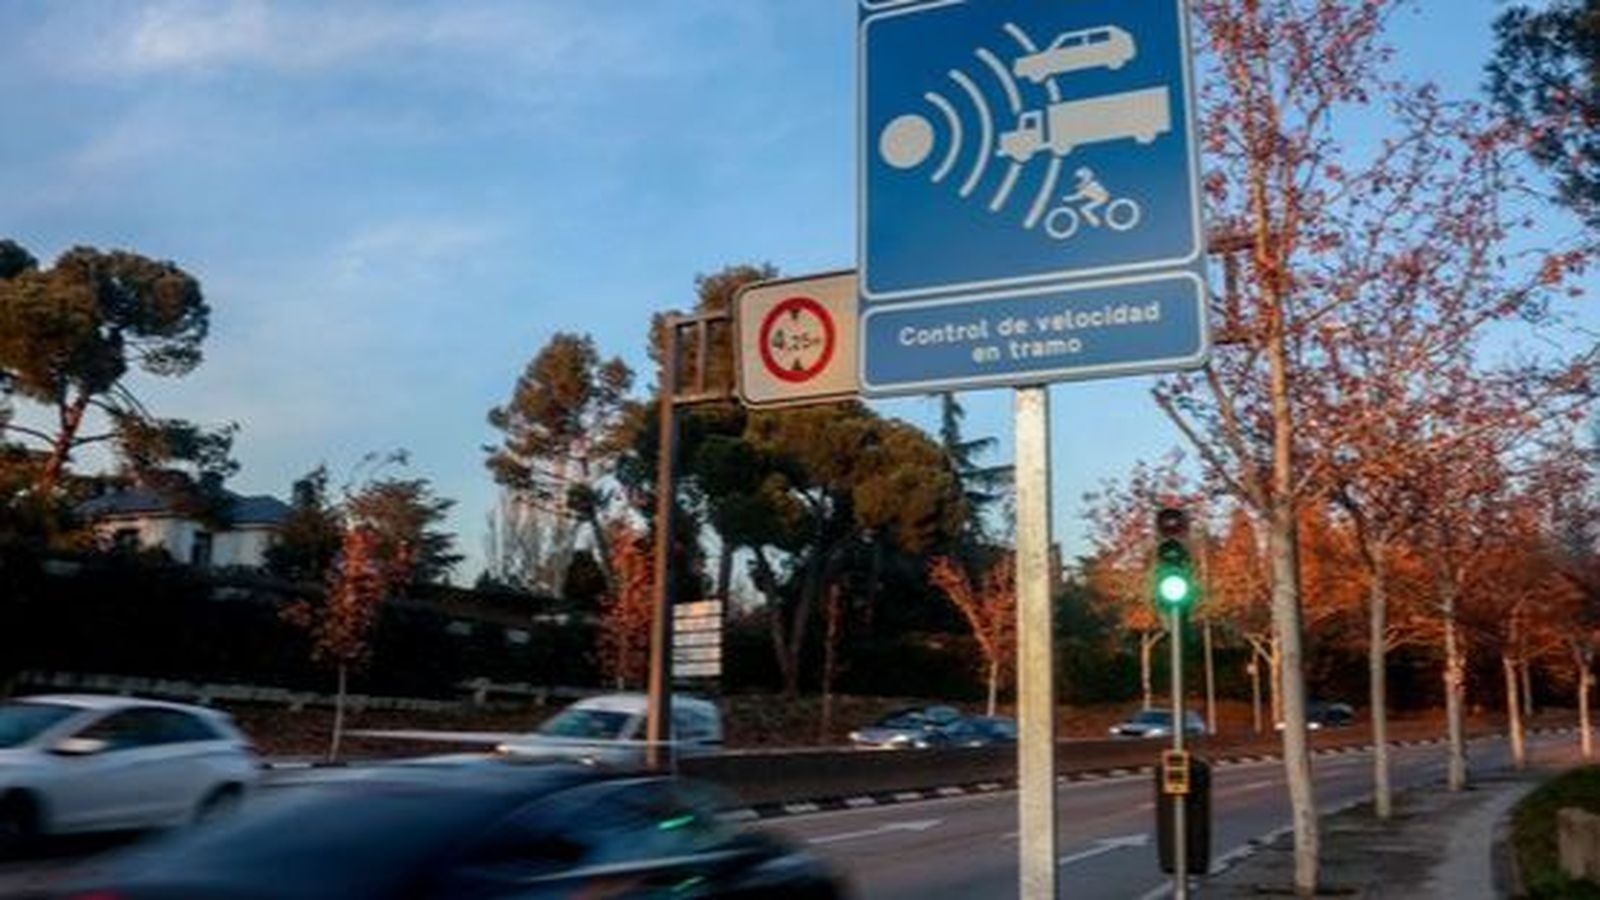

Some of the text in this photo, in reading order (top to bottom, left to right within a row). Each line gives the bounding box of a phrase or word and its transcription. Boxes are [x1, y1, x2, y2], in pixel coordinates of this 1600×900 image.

[899, 302, 1161, 347] Control de velocidad
[972, 337, 1082, 362] en tramo
